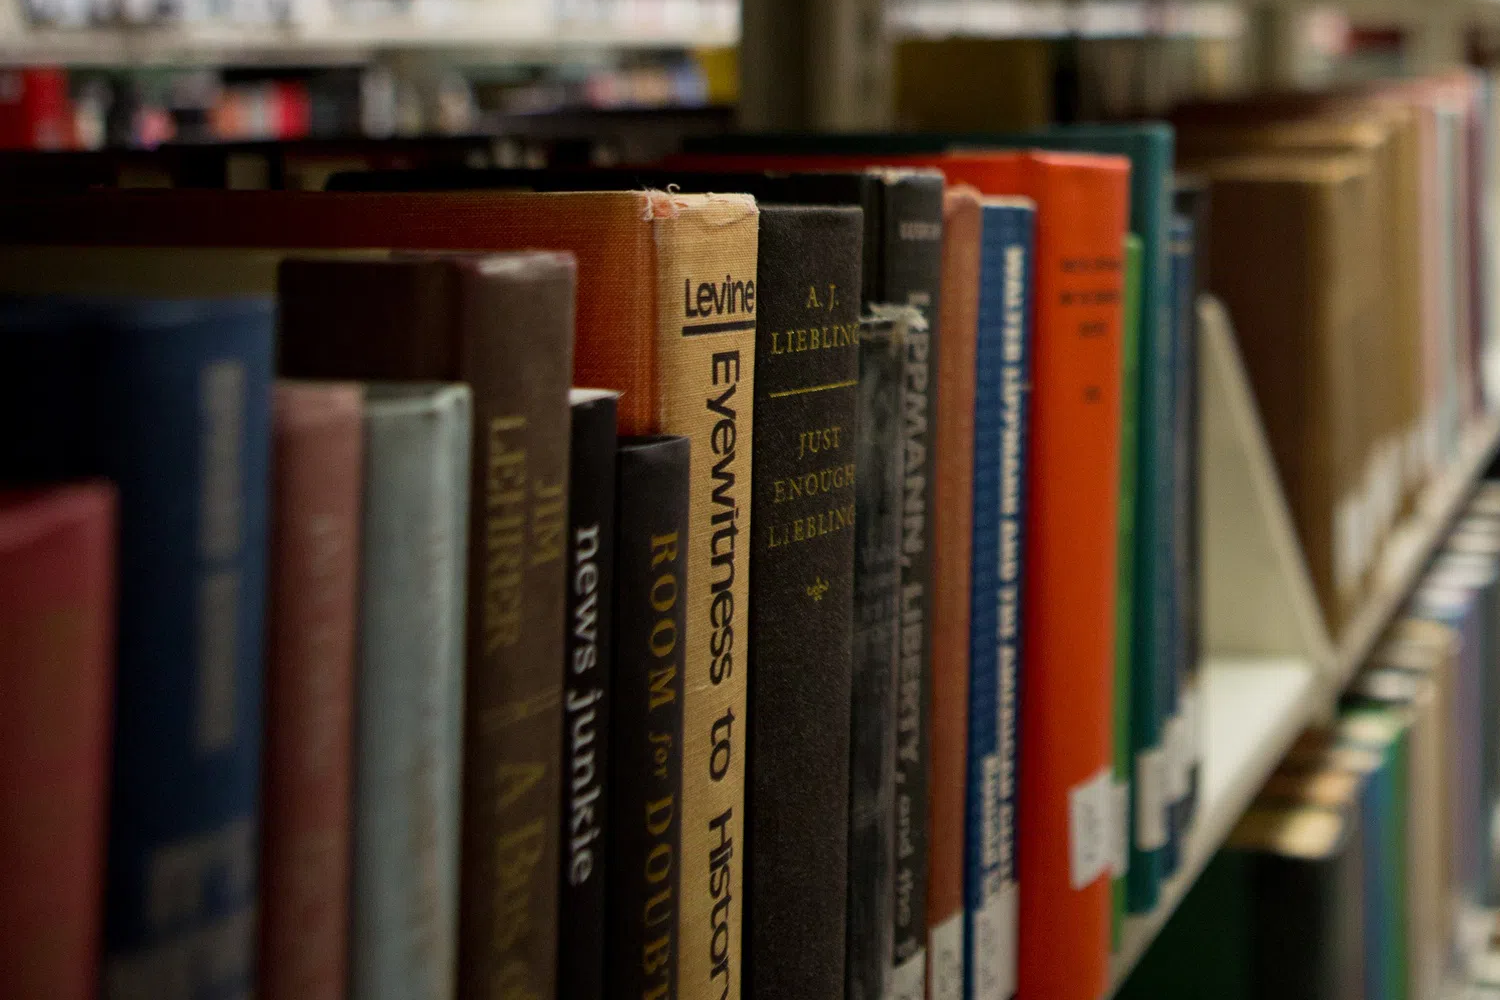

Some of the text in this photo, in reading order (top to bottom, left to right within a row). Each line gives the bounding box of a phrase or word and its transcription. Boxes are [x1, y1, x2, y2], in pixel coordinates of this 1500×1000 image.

[684, 274, 755, 319] Levine
[806, 283, 841, 313] A. J.
[799, 426, 843, 460] JUST
[901, 291, 931, 568] LPPMANN,
[773, 463, 857, 504] ENOUGH
[706, 349, 741, 688] Eyewitness
[646, 530, 679, 713] ROOM
[568, 525, 604, 888] news junkie
[647, 731, 673, 779] for
[709, 707, 737, 784] to
